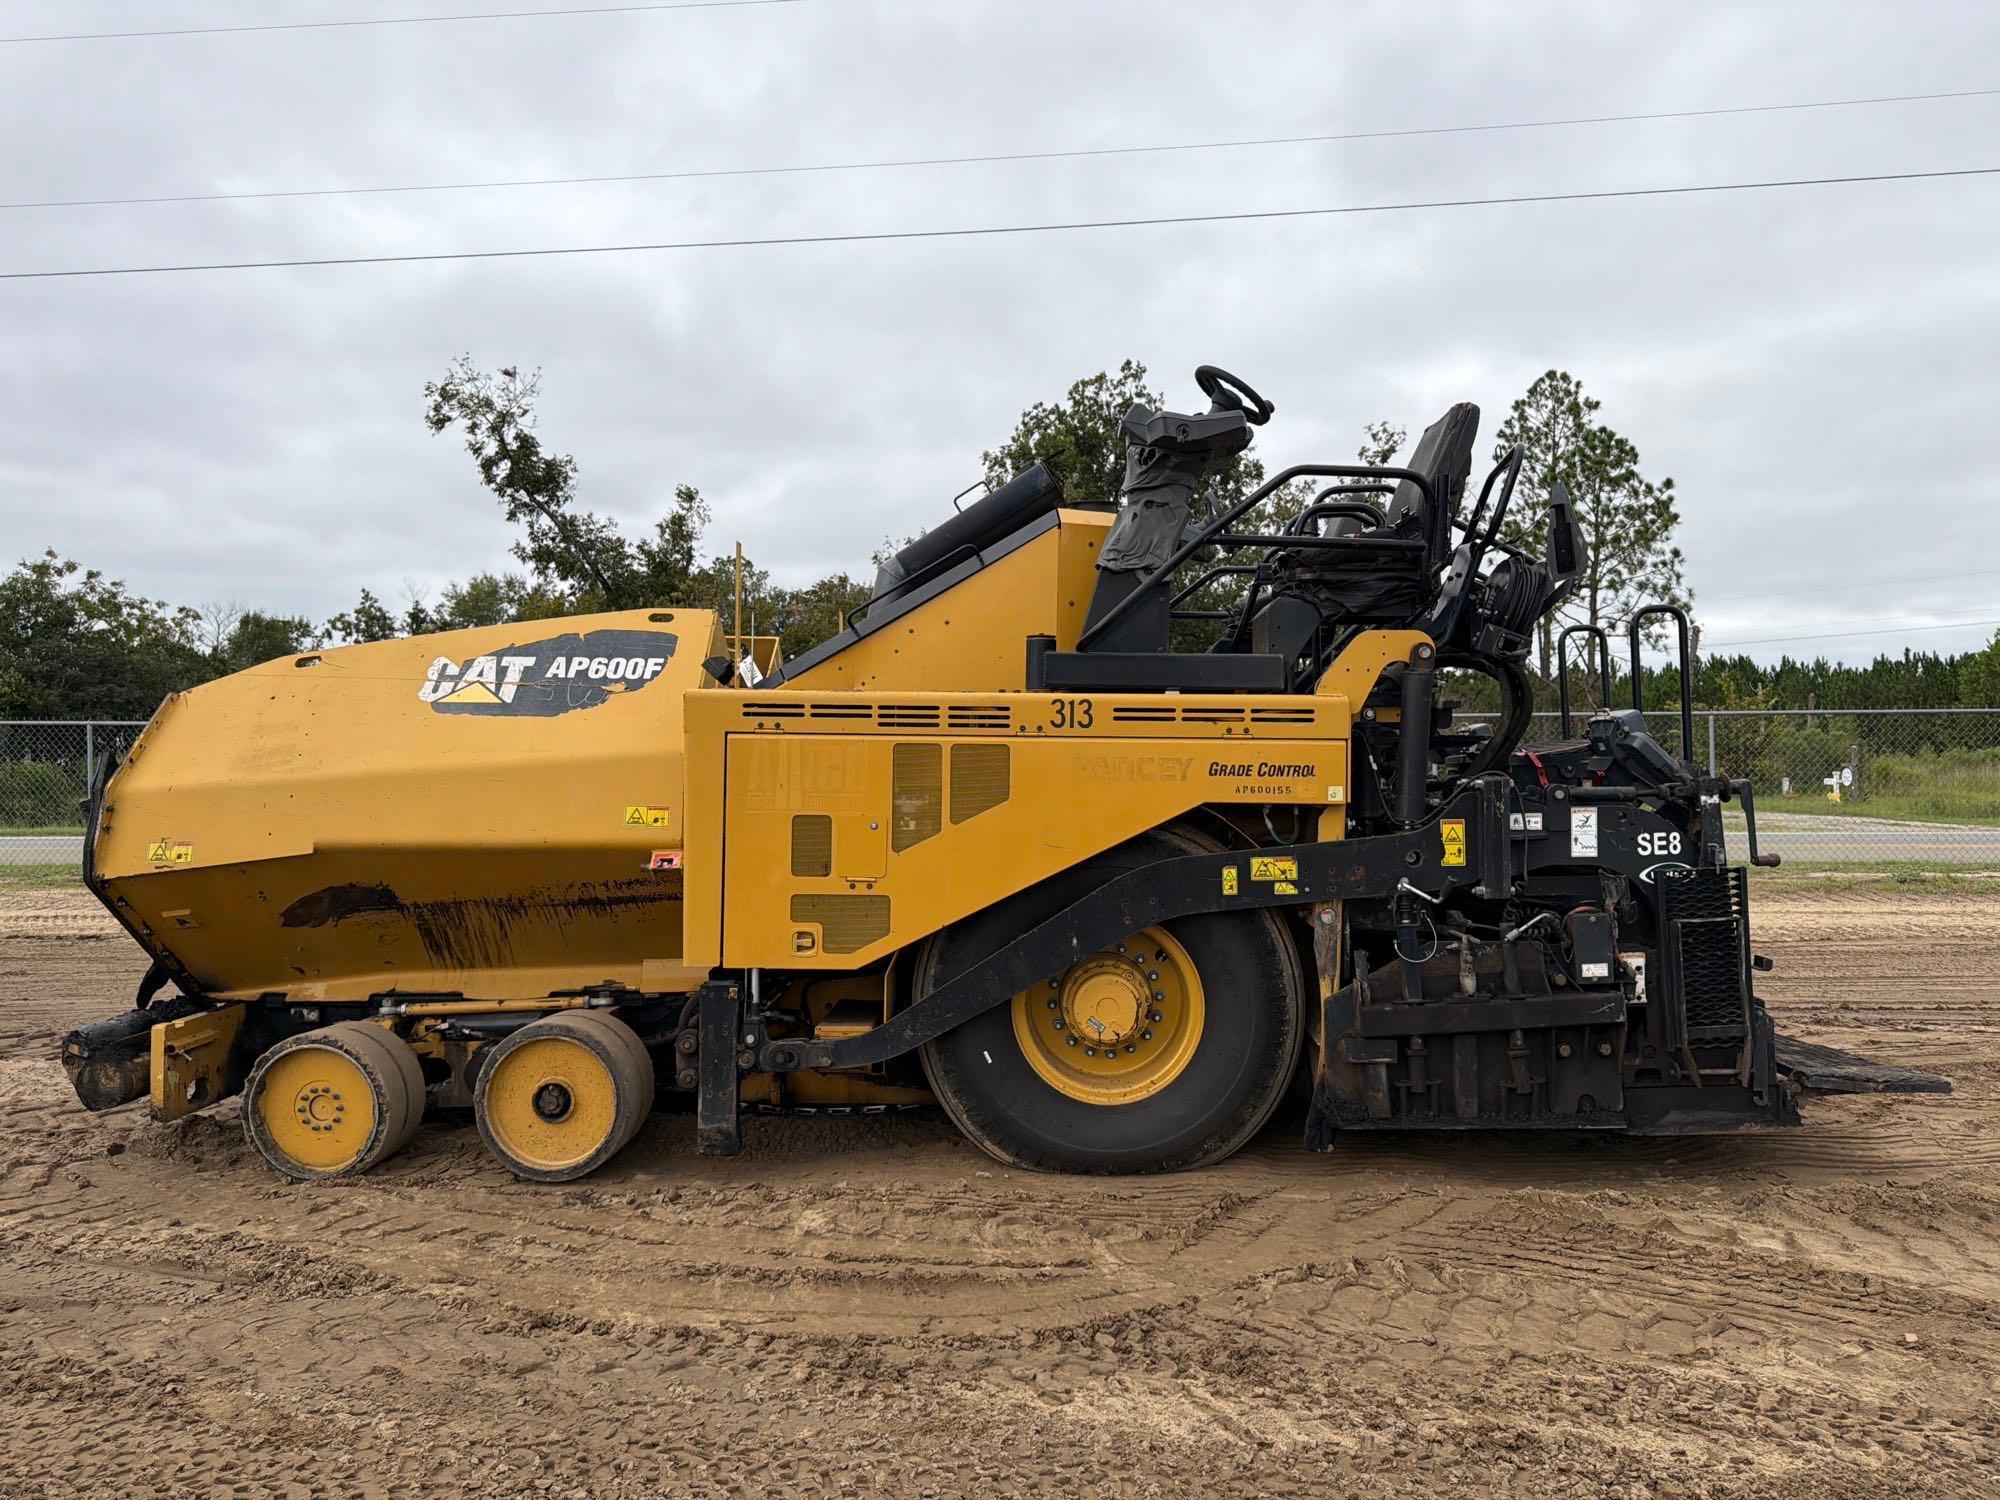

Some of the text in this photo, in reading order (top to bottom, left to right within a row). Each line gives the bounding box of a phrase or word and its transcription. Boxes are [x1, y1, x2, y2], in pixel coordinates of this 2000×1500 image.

[418, 655, 537, 704] CAT
[544, 656, 665, 680] AP600F
[1049, 698, 1094, 729] 313
[1208, 761, 1316, 778] GRADE CONTROL
[1234, 785, 1292, 795] AP600155
[1636, 831, 1682, 856] SE8
